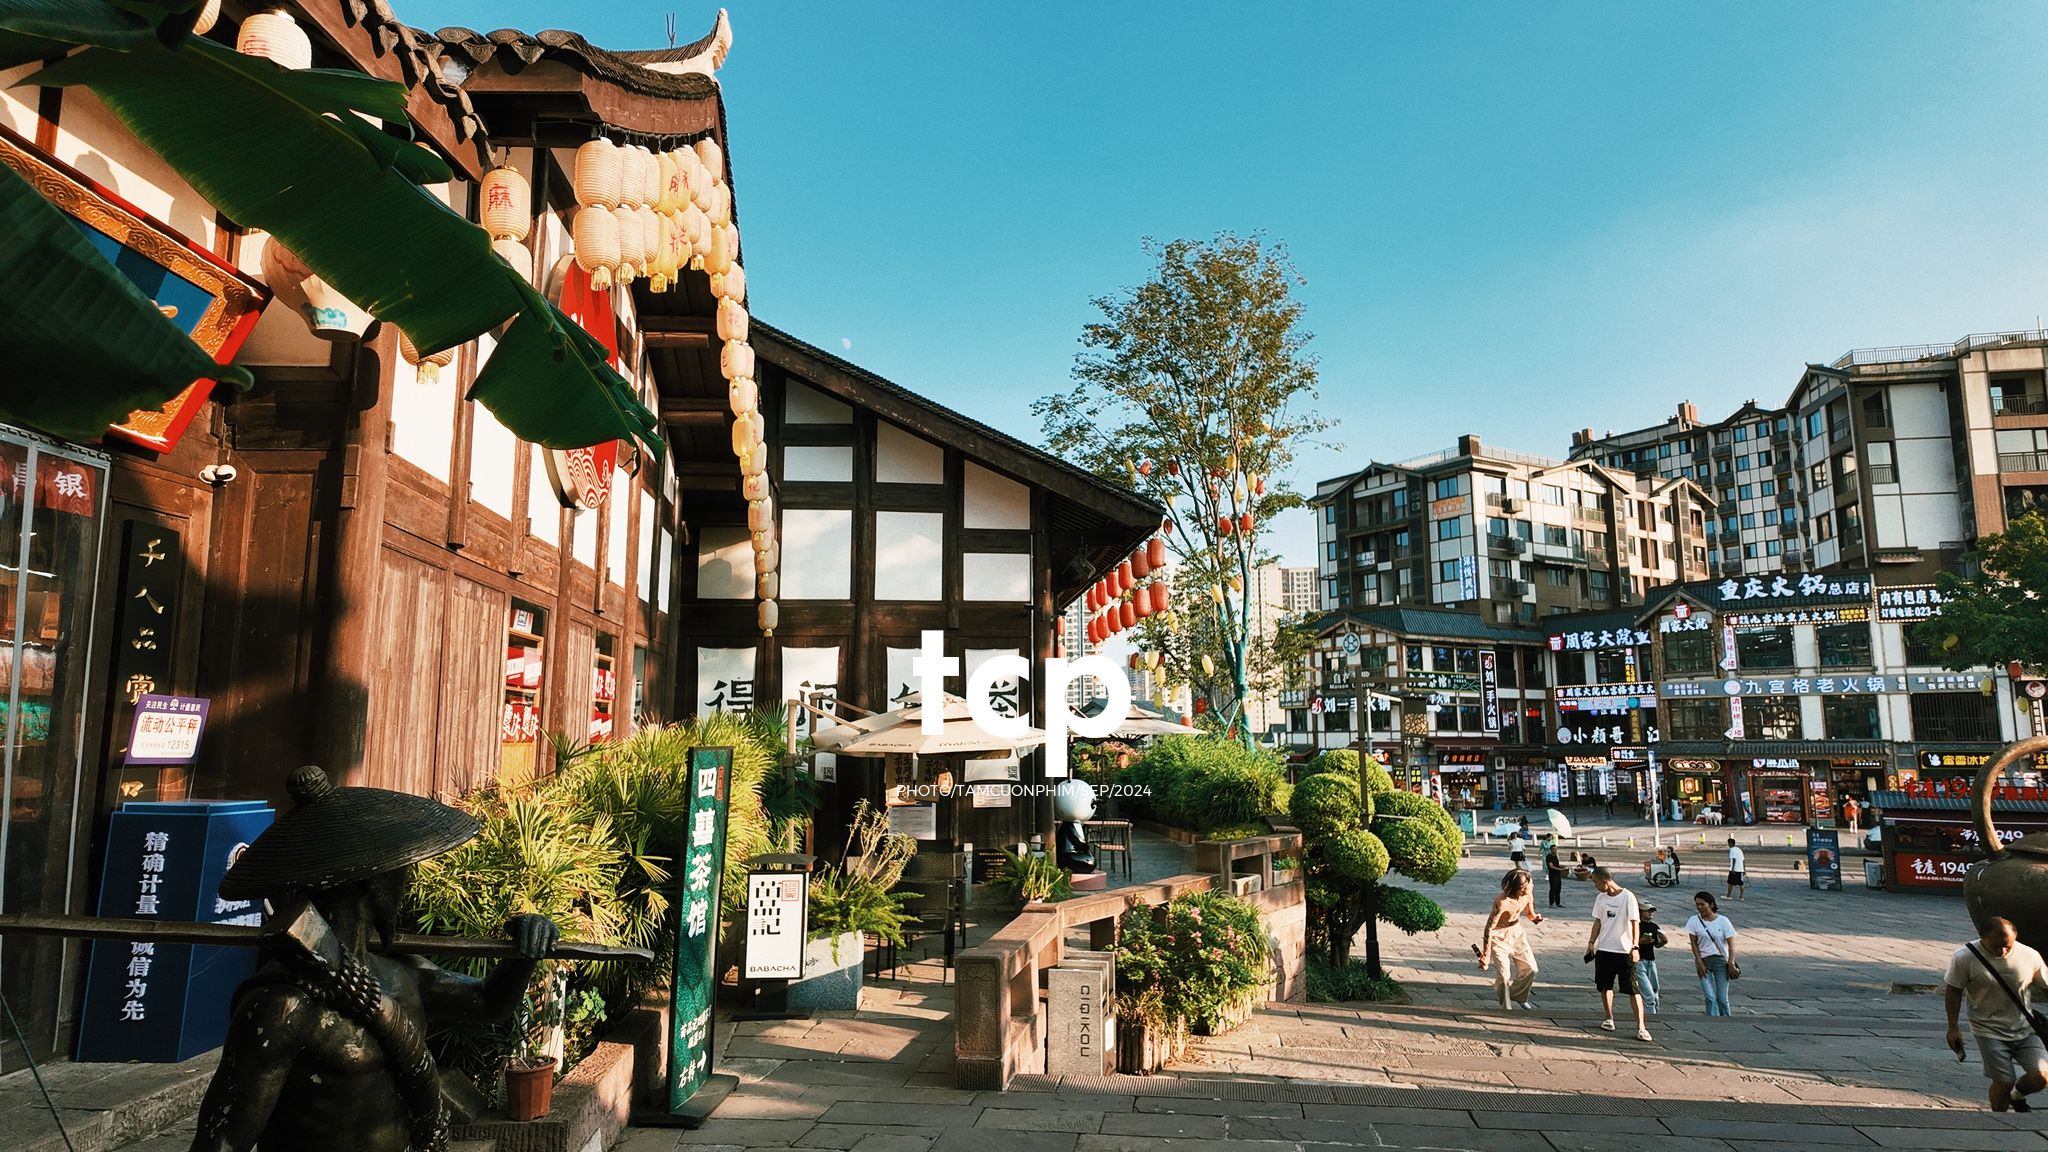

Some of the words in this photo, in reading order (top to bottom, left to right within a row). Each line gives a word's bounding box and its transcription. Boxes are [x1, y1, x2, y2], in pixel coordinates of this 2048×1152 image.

[53, 470, 87, 498] 银
[1484, 670, 1497, 729] 刘一手火锅
[1745, 677, 1886, 695] 九宫格老火锅
[140, 714, 199, 735] 流动公平秤
[166, 740, 190, 750] 12315
[134, 831, 169, 915] 精确计量
[686, 766, 717, 939] 四囍茶馆
[119, 941, 155, 1021] 诚信为先
[749, 965, 797, 973] BABACHA
[1080, 985, 1090, 1057] CIQIKOU
